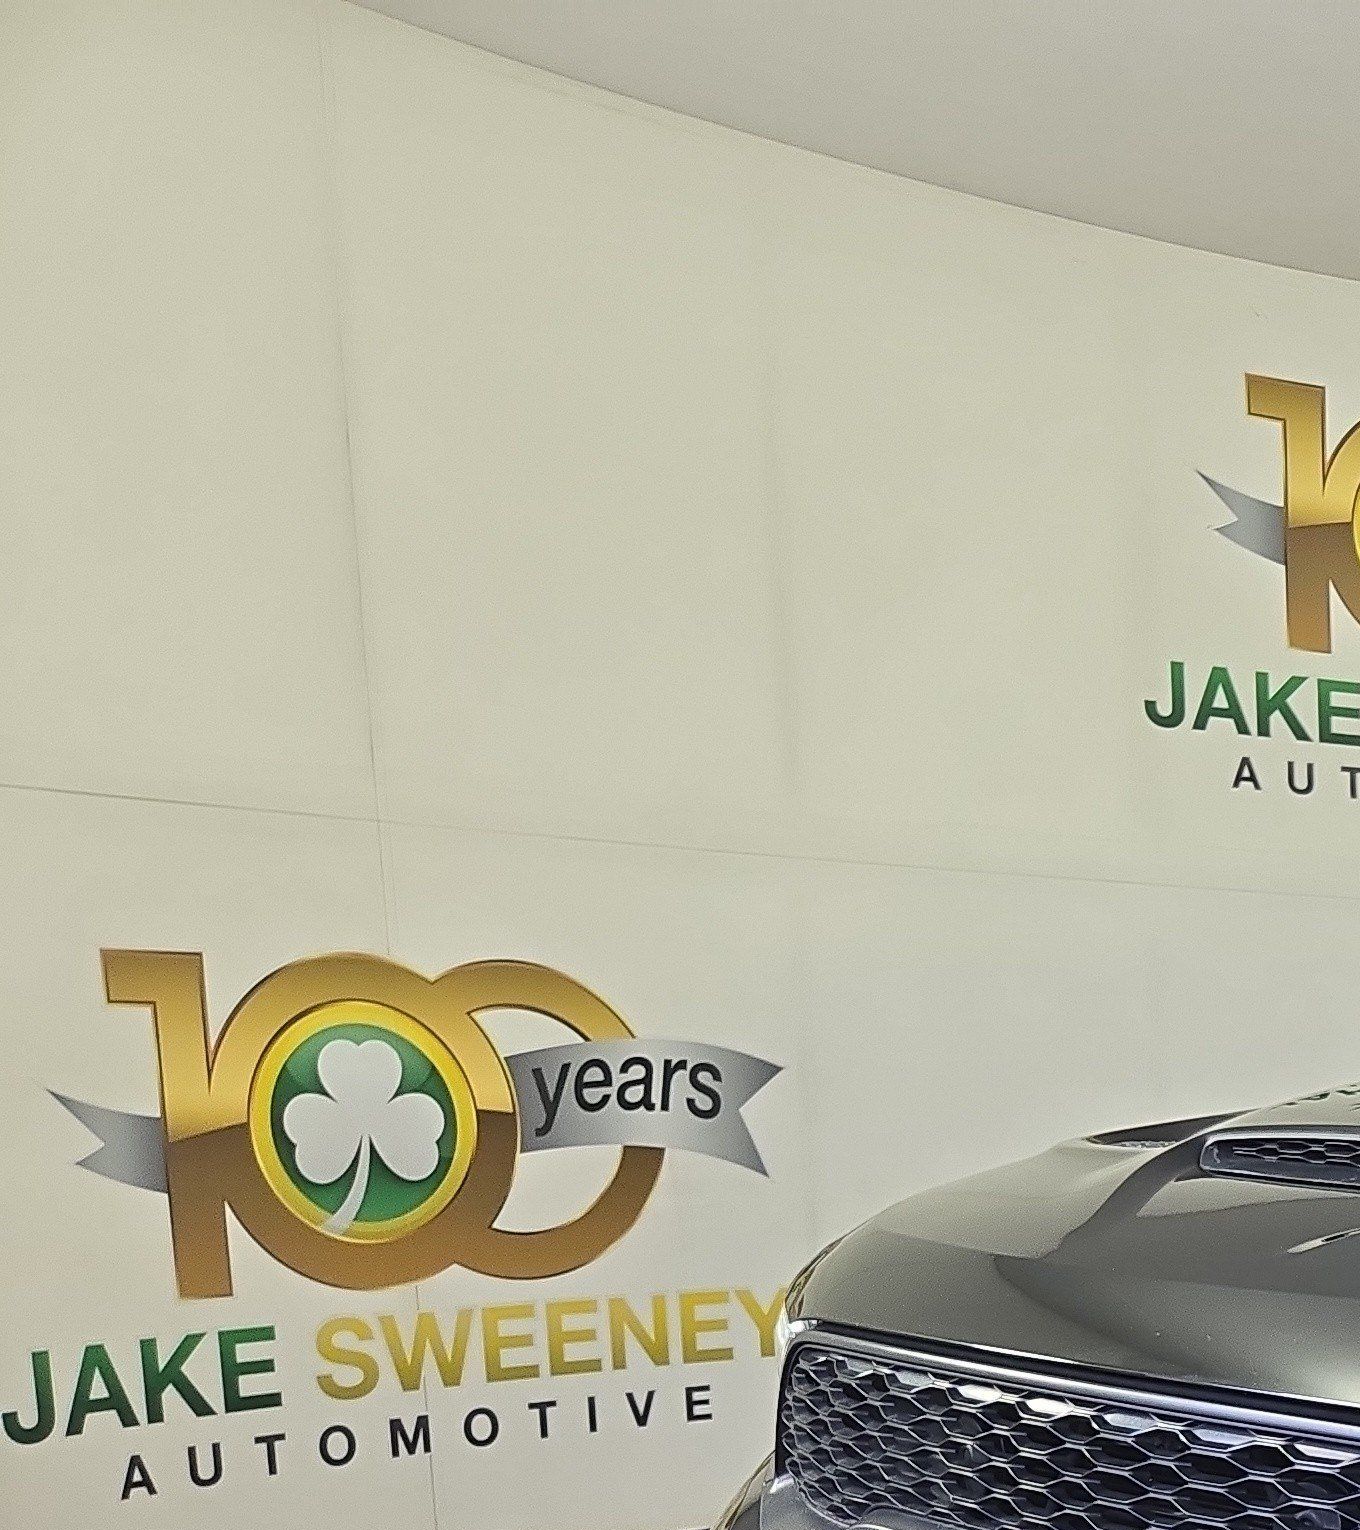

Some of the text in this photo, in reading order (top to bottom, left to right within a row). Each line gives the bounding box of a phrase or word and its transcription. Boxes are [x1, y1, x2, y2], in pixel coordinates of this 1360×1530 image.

[99, 947, 665, 1302] 100
[532, 1056, 724, 1138] years
[1, 1287, 788, 1445] JAKE SWEENEY
[120, 1384, 715, 1501] AUTOMOTIVE
